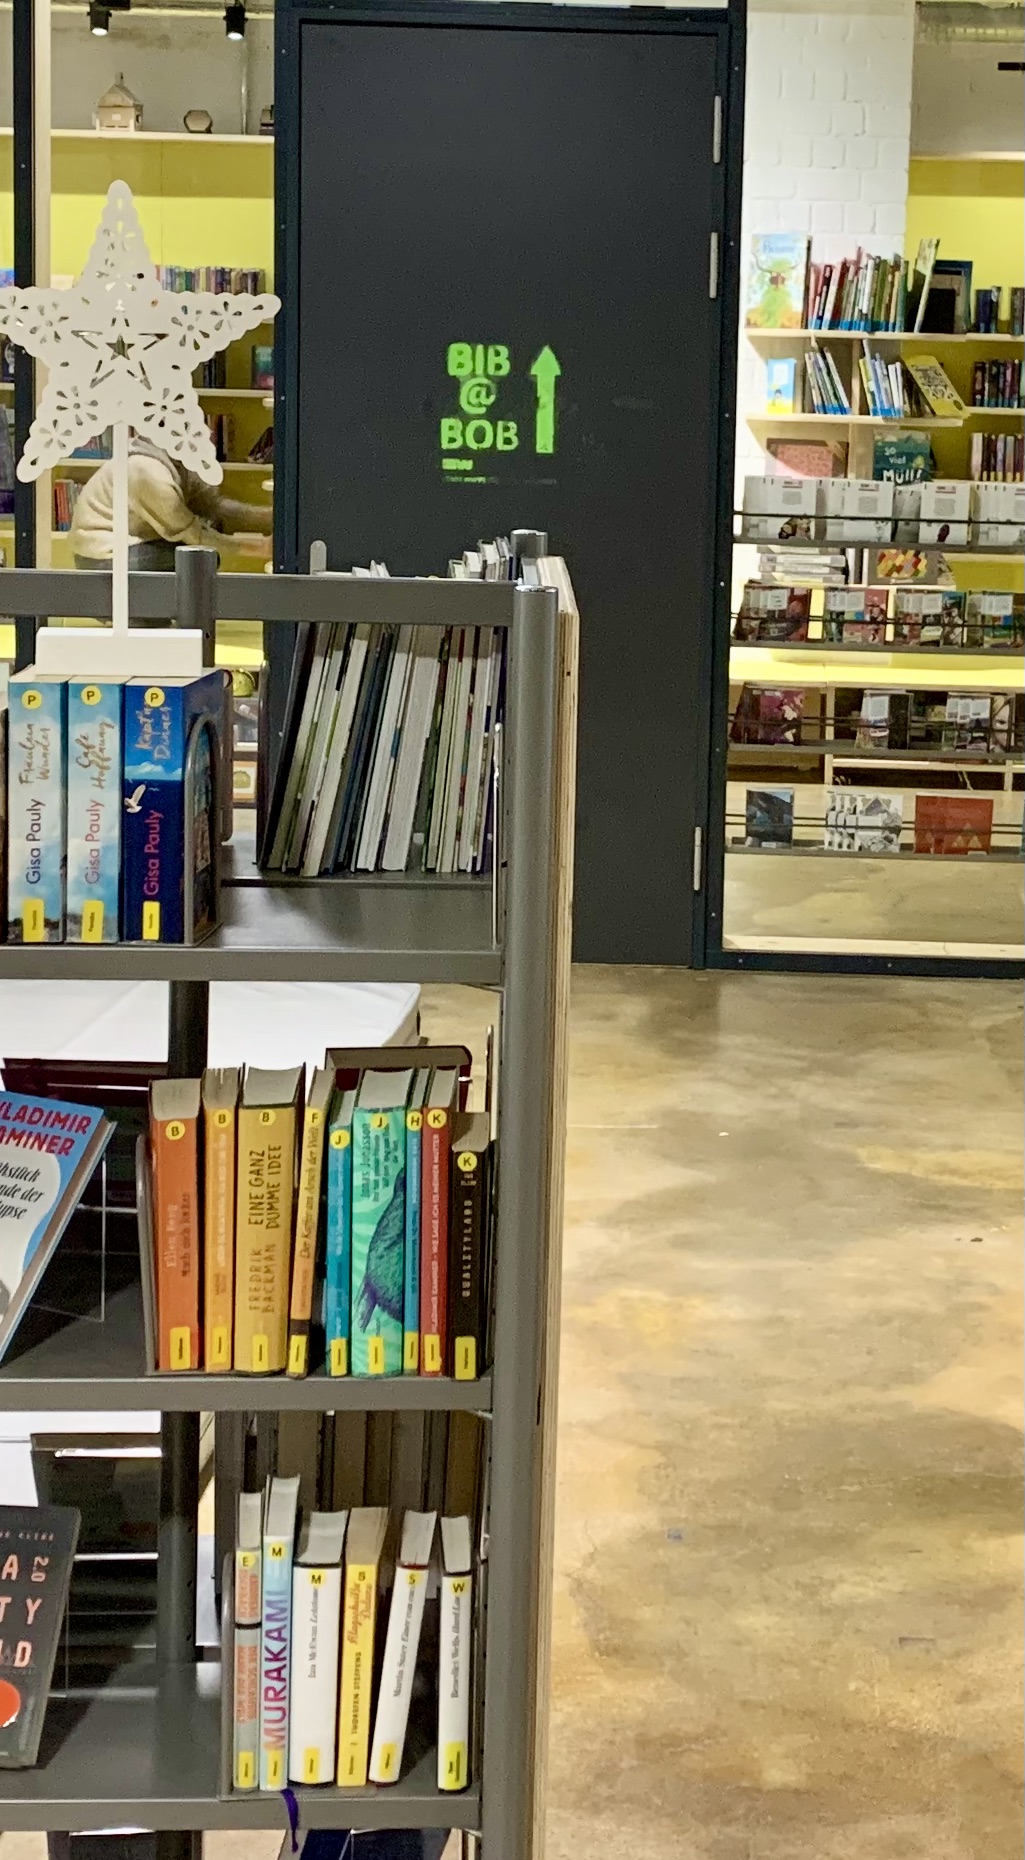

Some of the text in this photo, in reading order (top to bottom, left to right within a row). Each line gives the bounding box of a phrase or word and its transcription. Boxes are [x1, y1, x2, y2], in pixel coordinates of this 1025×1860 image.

[447, 342, 510, 376] BIB
[460, 378, 496, 414] @
[440, 418, 518, 450] BOB
[27, 694, 37, 706] P
[86, 690, 96, 701] P
[149, 692, 159, 704] P
[26, 798, 45, 884] Gisa Pauly
[84, 800, 105, 884] Gisa Pauly
[143, 810, 164, 896] Gisa Pauly
[311, 1111, 319, 1124] F
[376, 1115, 384, 1128] J
[409, 1115, 420, 1128] H
[431, 1112, 442, 1125] K
[334, 1134, 343, 1146] J
[461, 1157, 473, 1169] K
[248, 1150, 265, 1226] EINE GANZ
[266, 1144, 281, 1229] DUMME IDEE
[21, 1187, 44, 1203] der
[248, 1249, 262, 1311] FREDRIK
[261, 1243, 275, 1313] BACKMAN
[271, 1547, 283, 1558] M
[31, 1555, 49, 1582] 2.0
[311, 1574, 322, 1585] M
[452, 1581, 466, 1593] W
[263, 1589, 287, 1751] MURAKAMI
